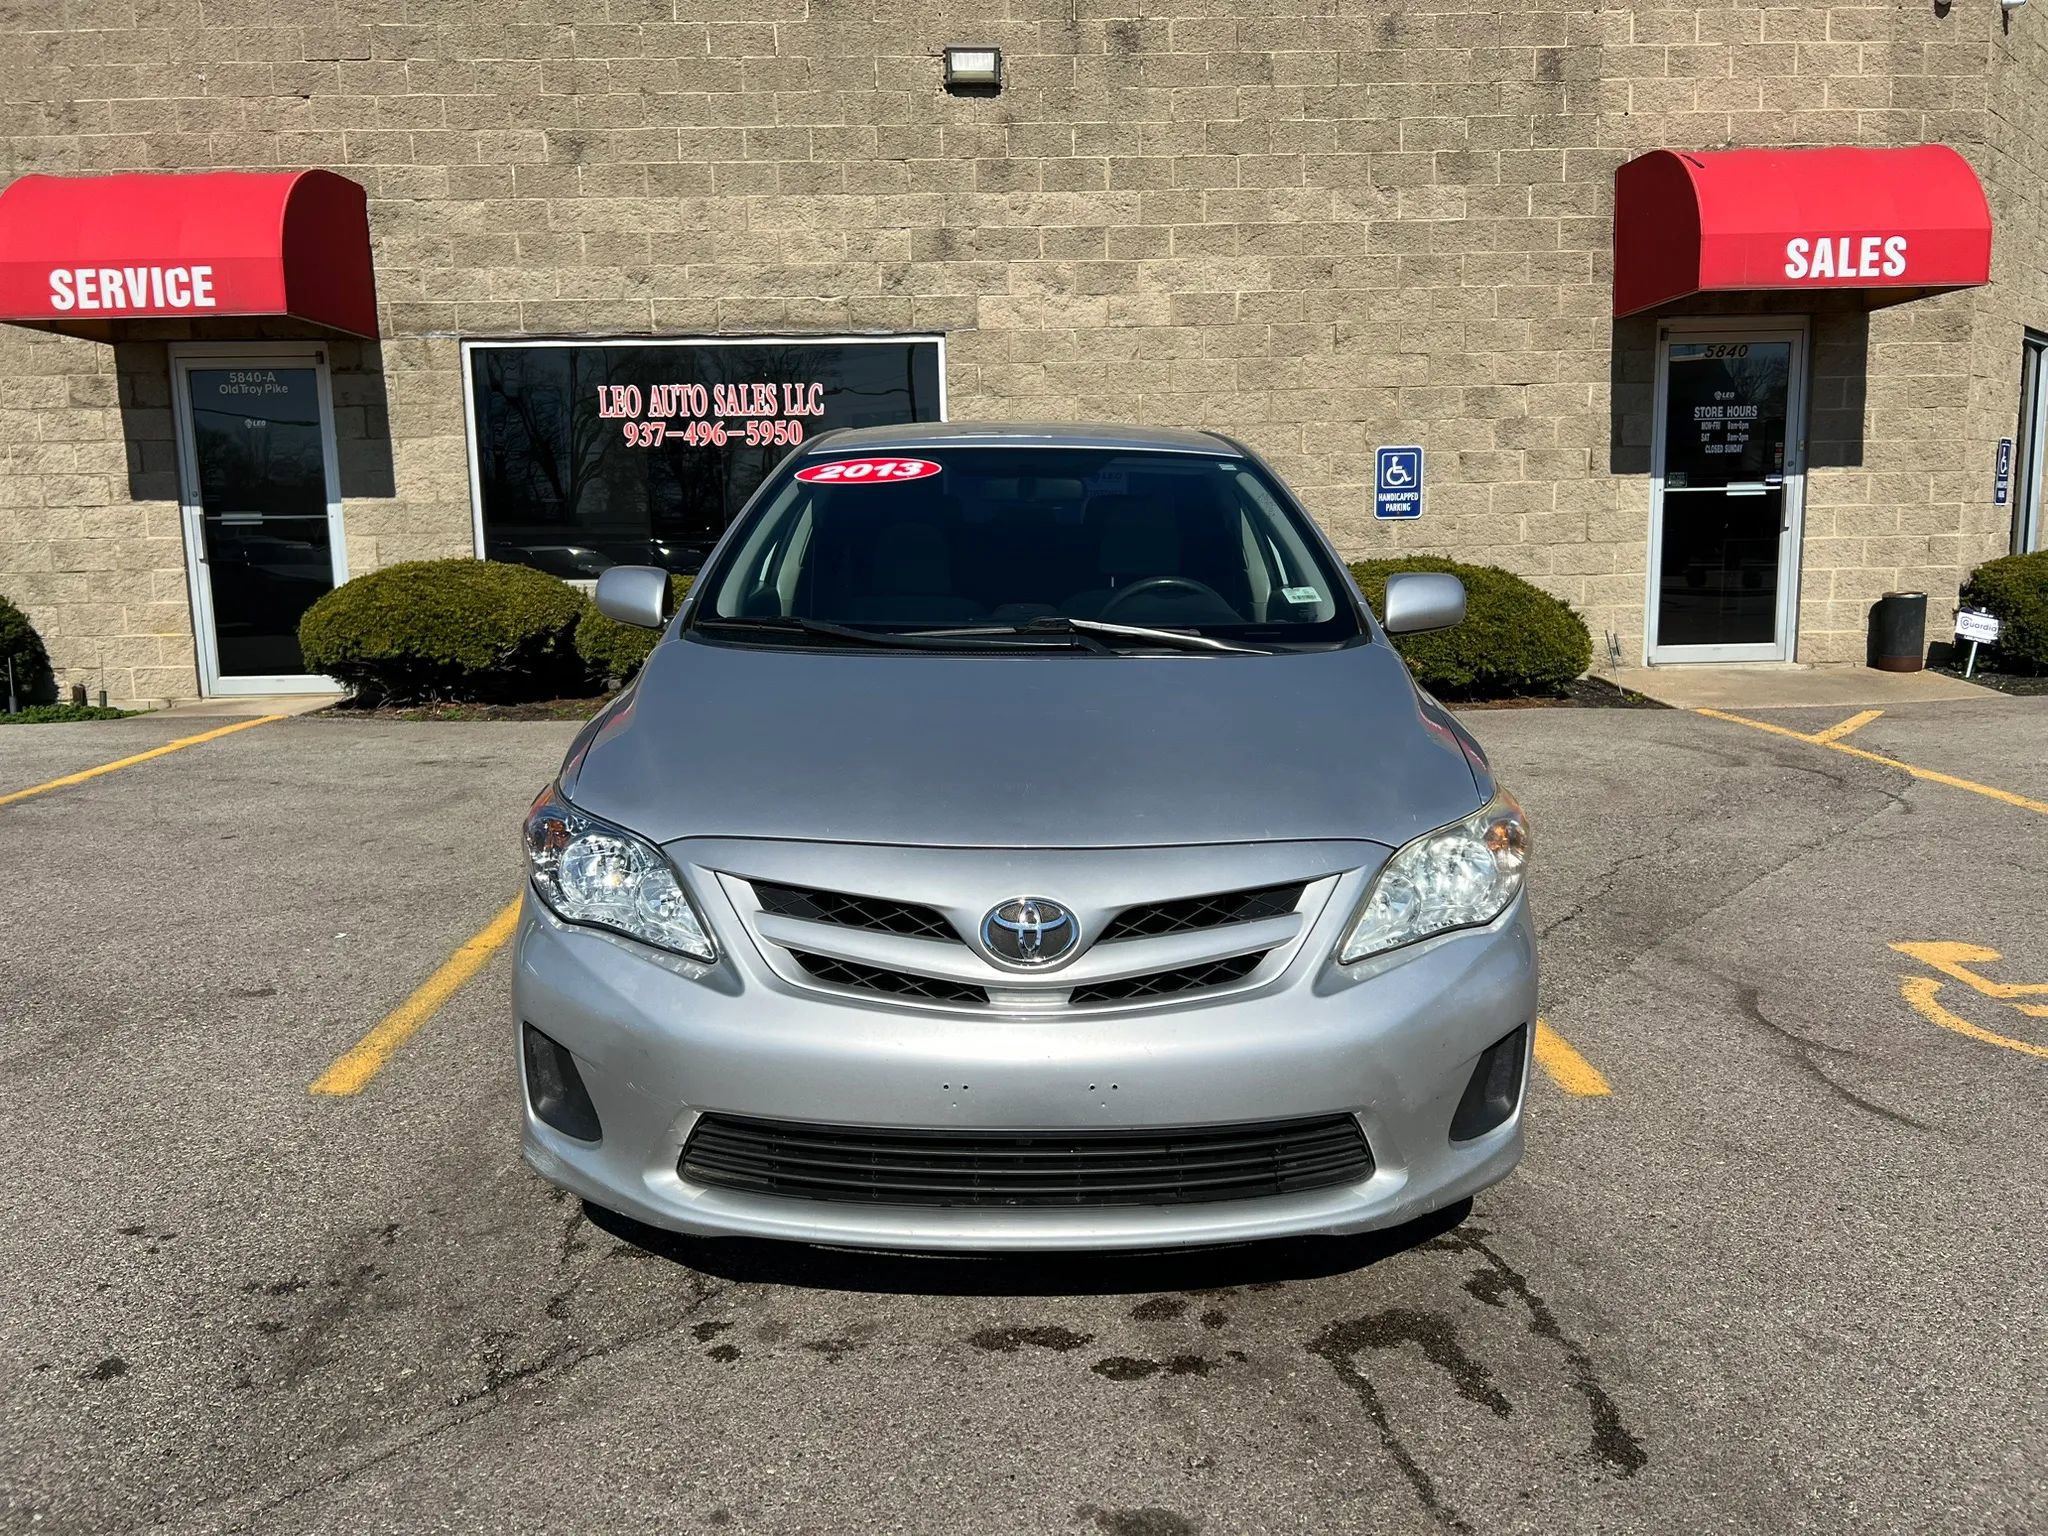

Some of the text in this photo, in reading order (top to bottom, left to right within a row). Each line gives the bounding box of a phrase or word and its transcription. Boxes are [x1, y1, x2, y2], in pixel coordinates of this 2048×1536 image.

[1785, 235, 1907, 279] SALES
[50, 265, 216, 311] SERVICE
[1704, 344, 1748, 358] 5840
[229, 371, 276, 383] 5840-A
[219, 383, 289, 396] Old Troy Pike
[598, 383, 825, 418] LEO AUTO SALES LLC
[1694, 405, 1758, 418] STORE HOURS
[623, 420, 804, 447] 937-496-5950
[1701, 433, 1710, 442] SAT
[1705, 444, 1743, 453] CLOSED SUNDAY
[812, 461, 925, 481] 2013
[1378, 492, 1419, 501] HANDICAPPED
[1385, 502, 1411, 512] PARKING
[1961, 616, 1998, 632] Guardia
